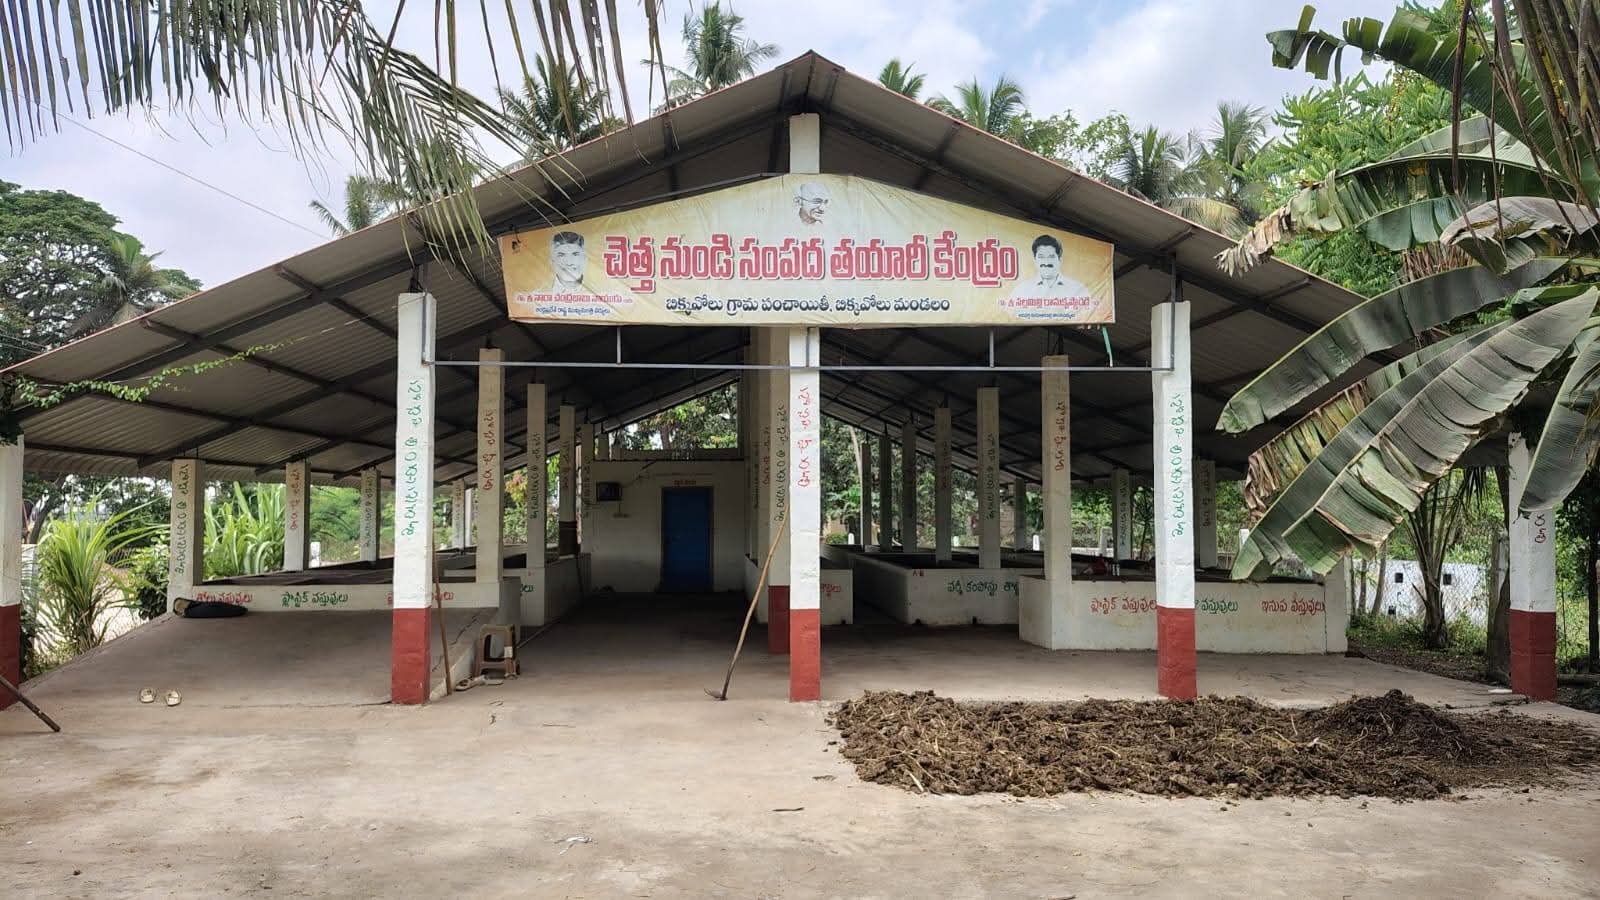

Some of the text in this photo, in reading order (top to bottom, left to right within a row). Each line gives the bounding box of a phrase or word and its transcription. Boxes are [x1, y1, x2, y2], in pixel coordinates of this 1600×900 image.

[603, 230, 1019, 294] చెత్త నుండి సంపద తయారీ కేంద్రం
[665, 294, 723, 315] బిక్కవోలు
[726, 297, 758, 316] గ్రామ
[835, 294, 891, 316] బిక్కవోలు
[893, 297, 951, 311] మండలం
